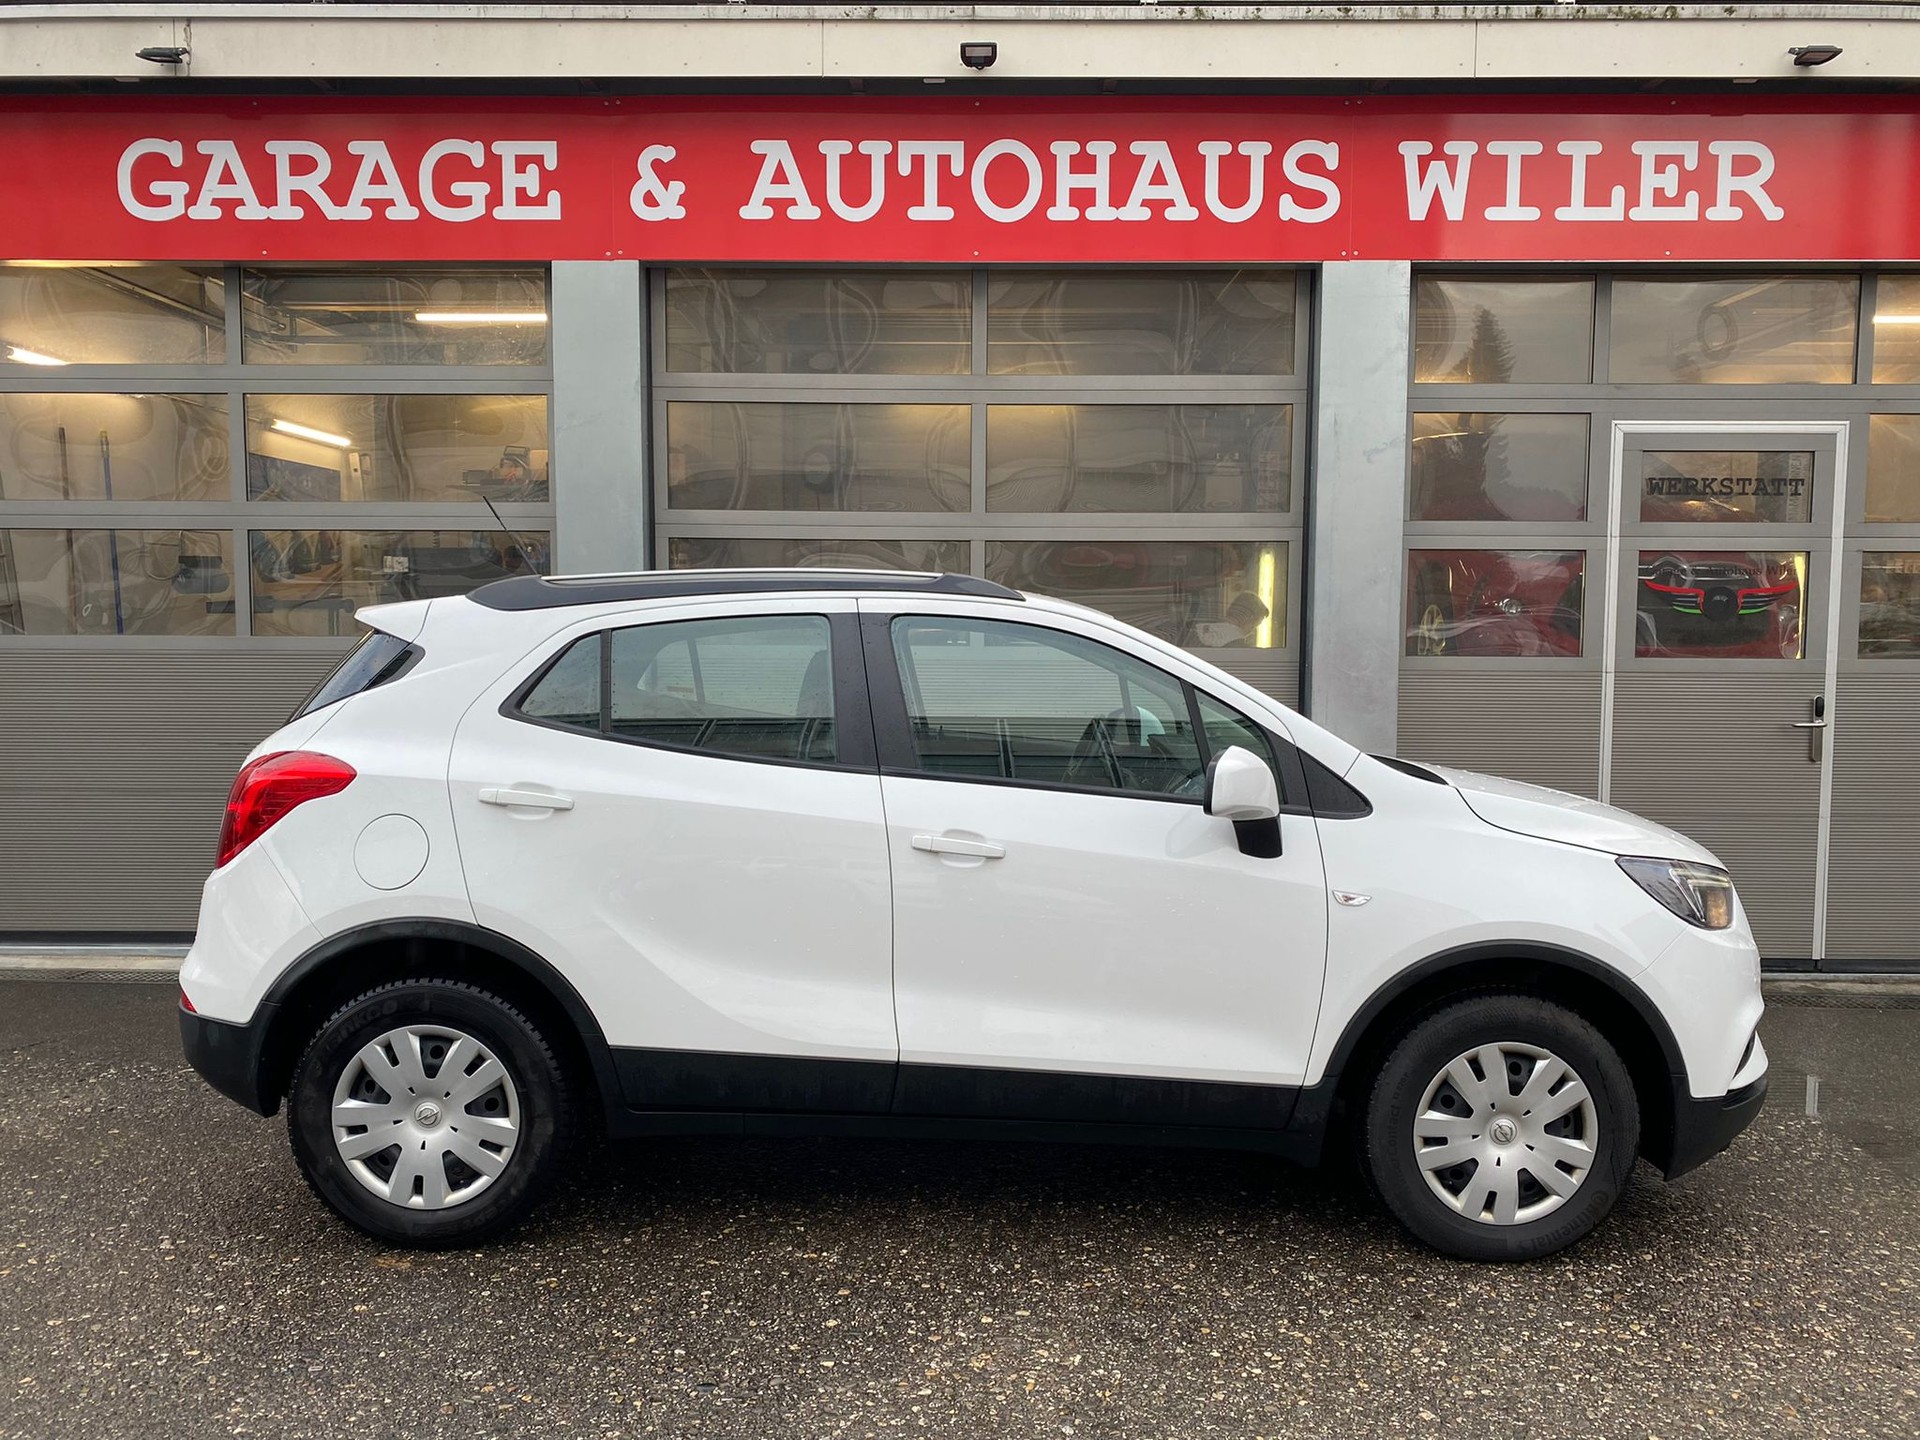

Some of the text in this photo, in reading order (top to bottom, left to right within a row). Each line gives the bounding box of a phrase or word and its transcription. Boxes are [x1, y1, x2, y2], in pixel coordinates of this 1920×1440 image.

[118, 138, 1785, 224] GARAGE & AUTOHAUS WILER
[1646, 477, 1805, 497] WERKSTATT
